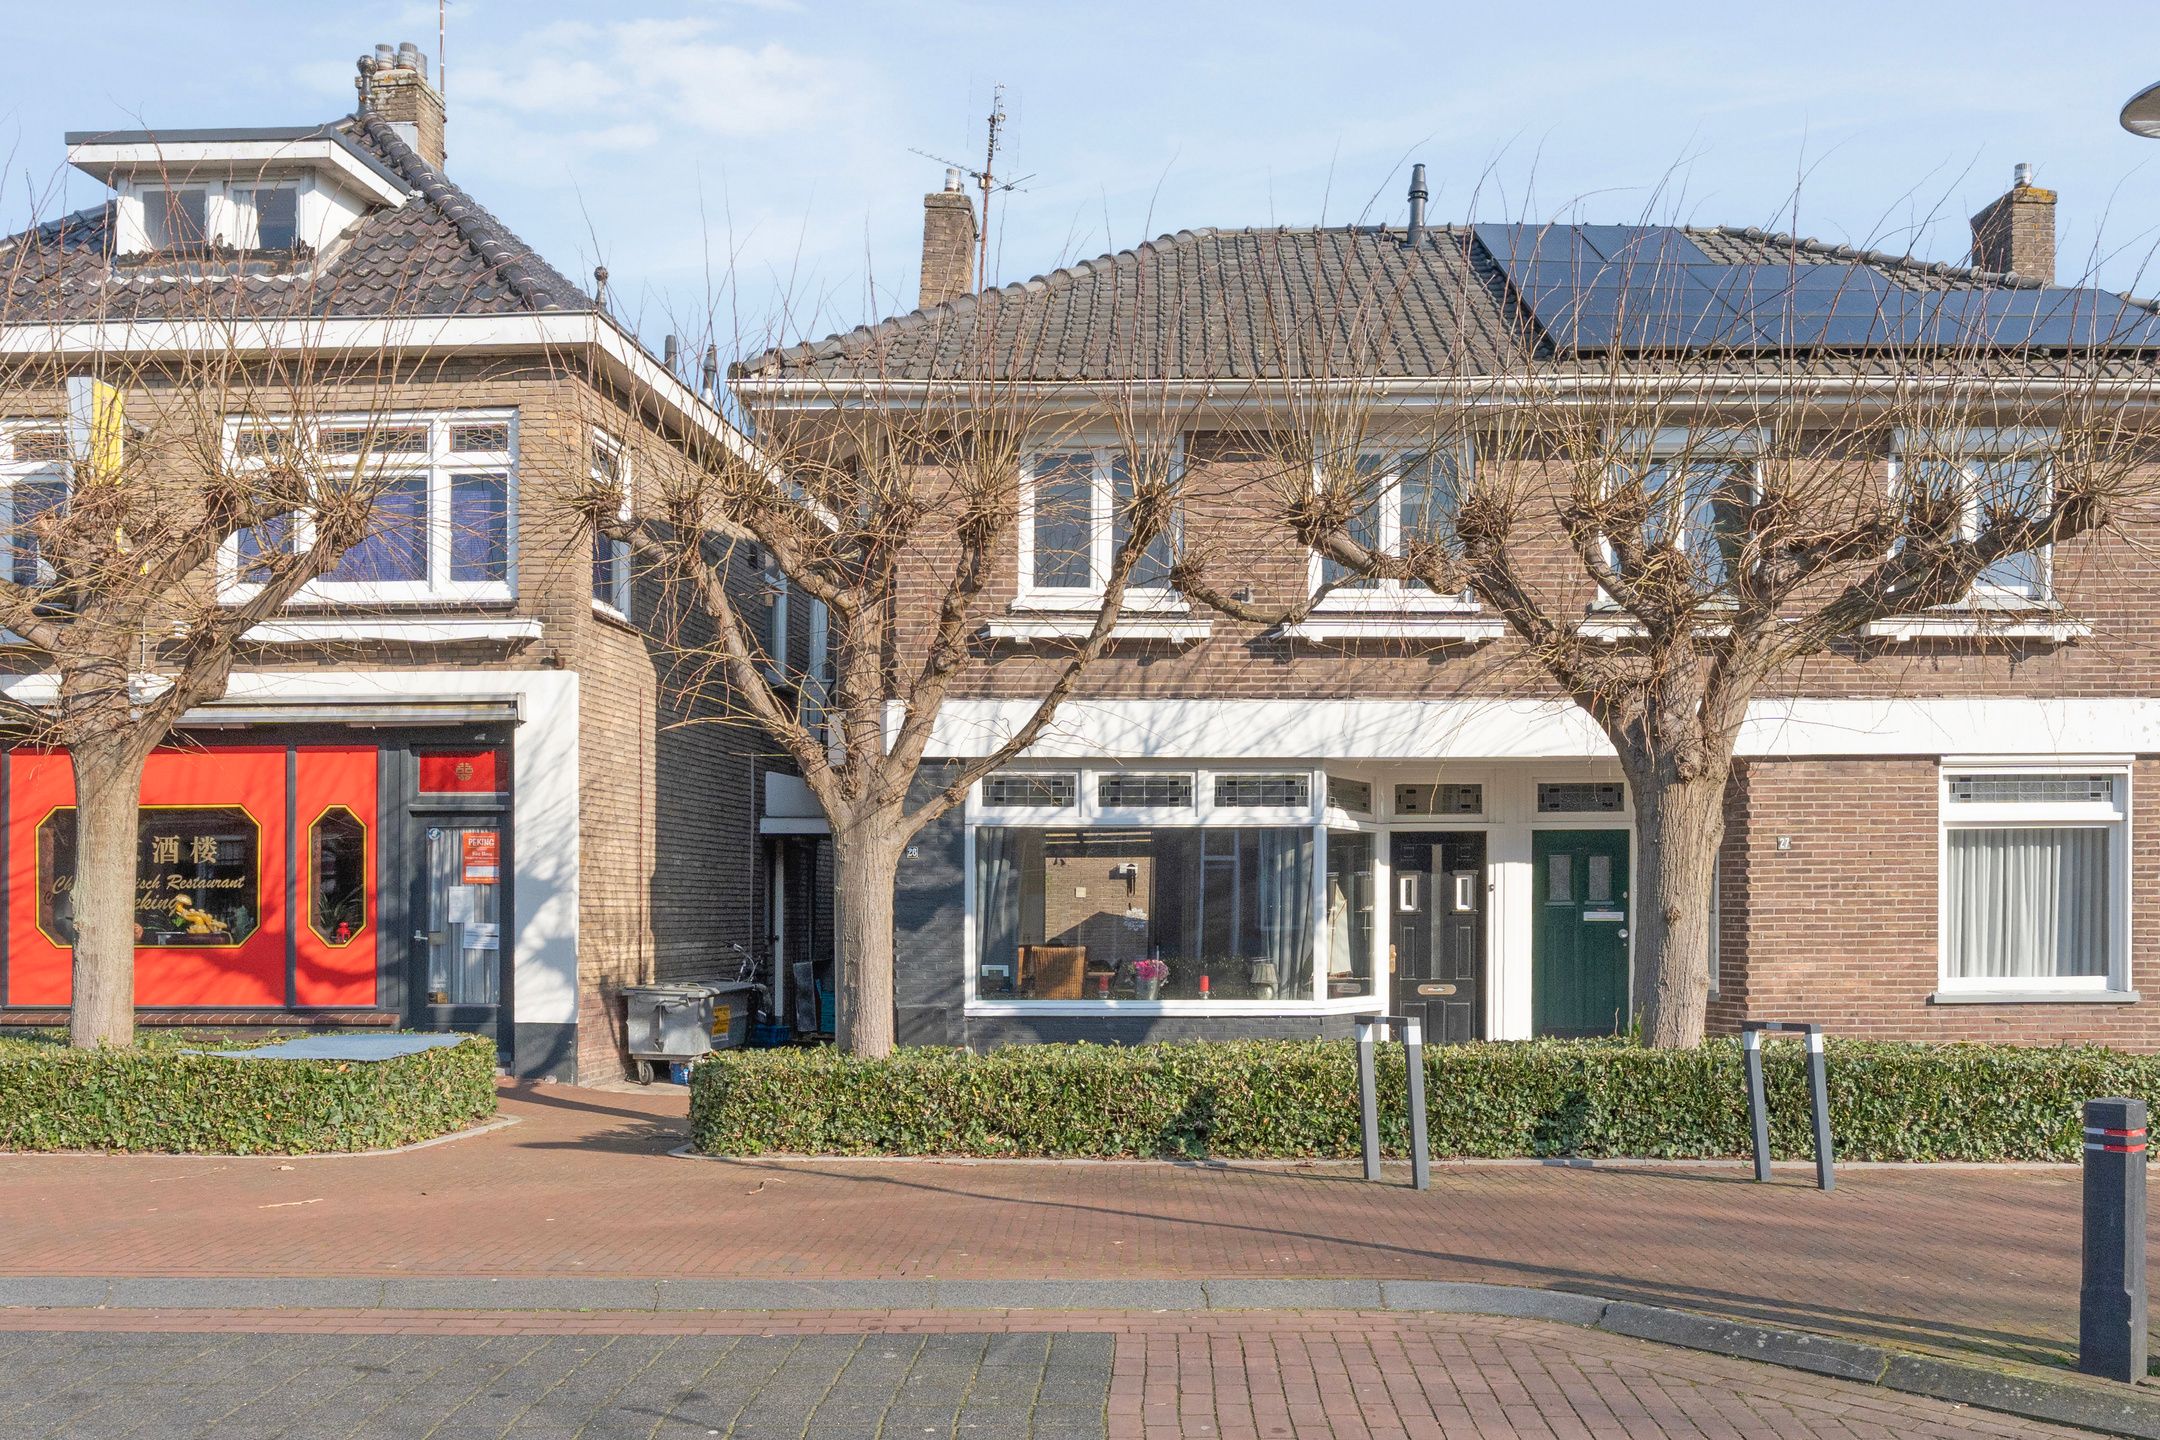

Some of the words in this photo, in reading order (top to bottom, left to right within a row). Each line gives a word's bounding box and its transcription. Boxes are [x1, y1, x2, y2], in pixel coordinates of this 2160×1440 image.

[137, 835, 217, 864] 酒楼
[468, 838, 495, 846] PEKING
[1780, 837, 1790, 848] 27
[166, 874, 246, 890] Restaurant
[135, 890, 178, 917] eking
